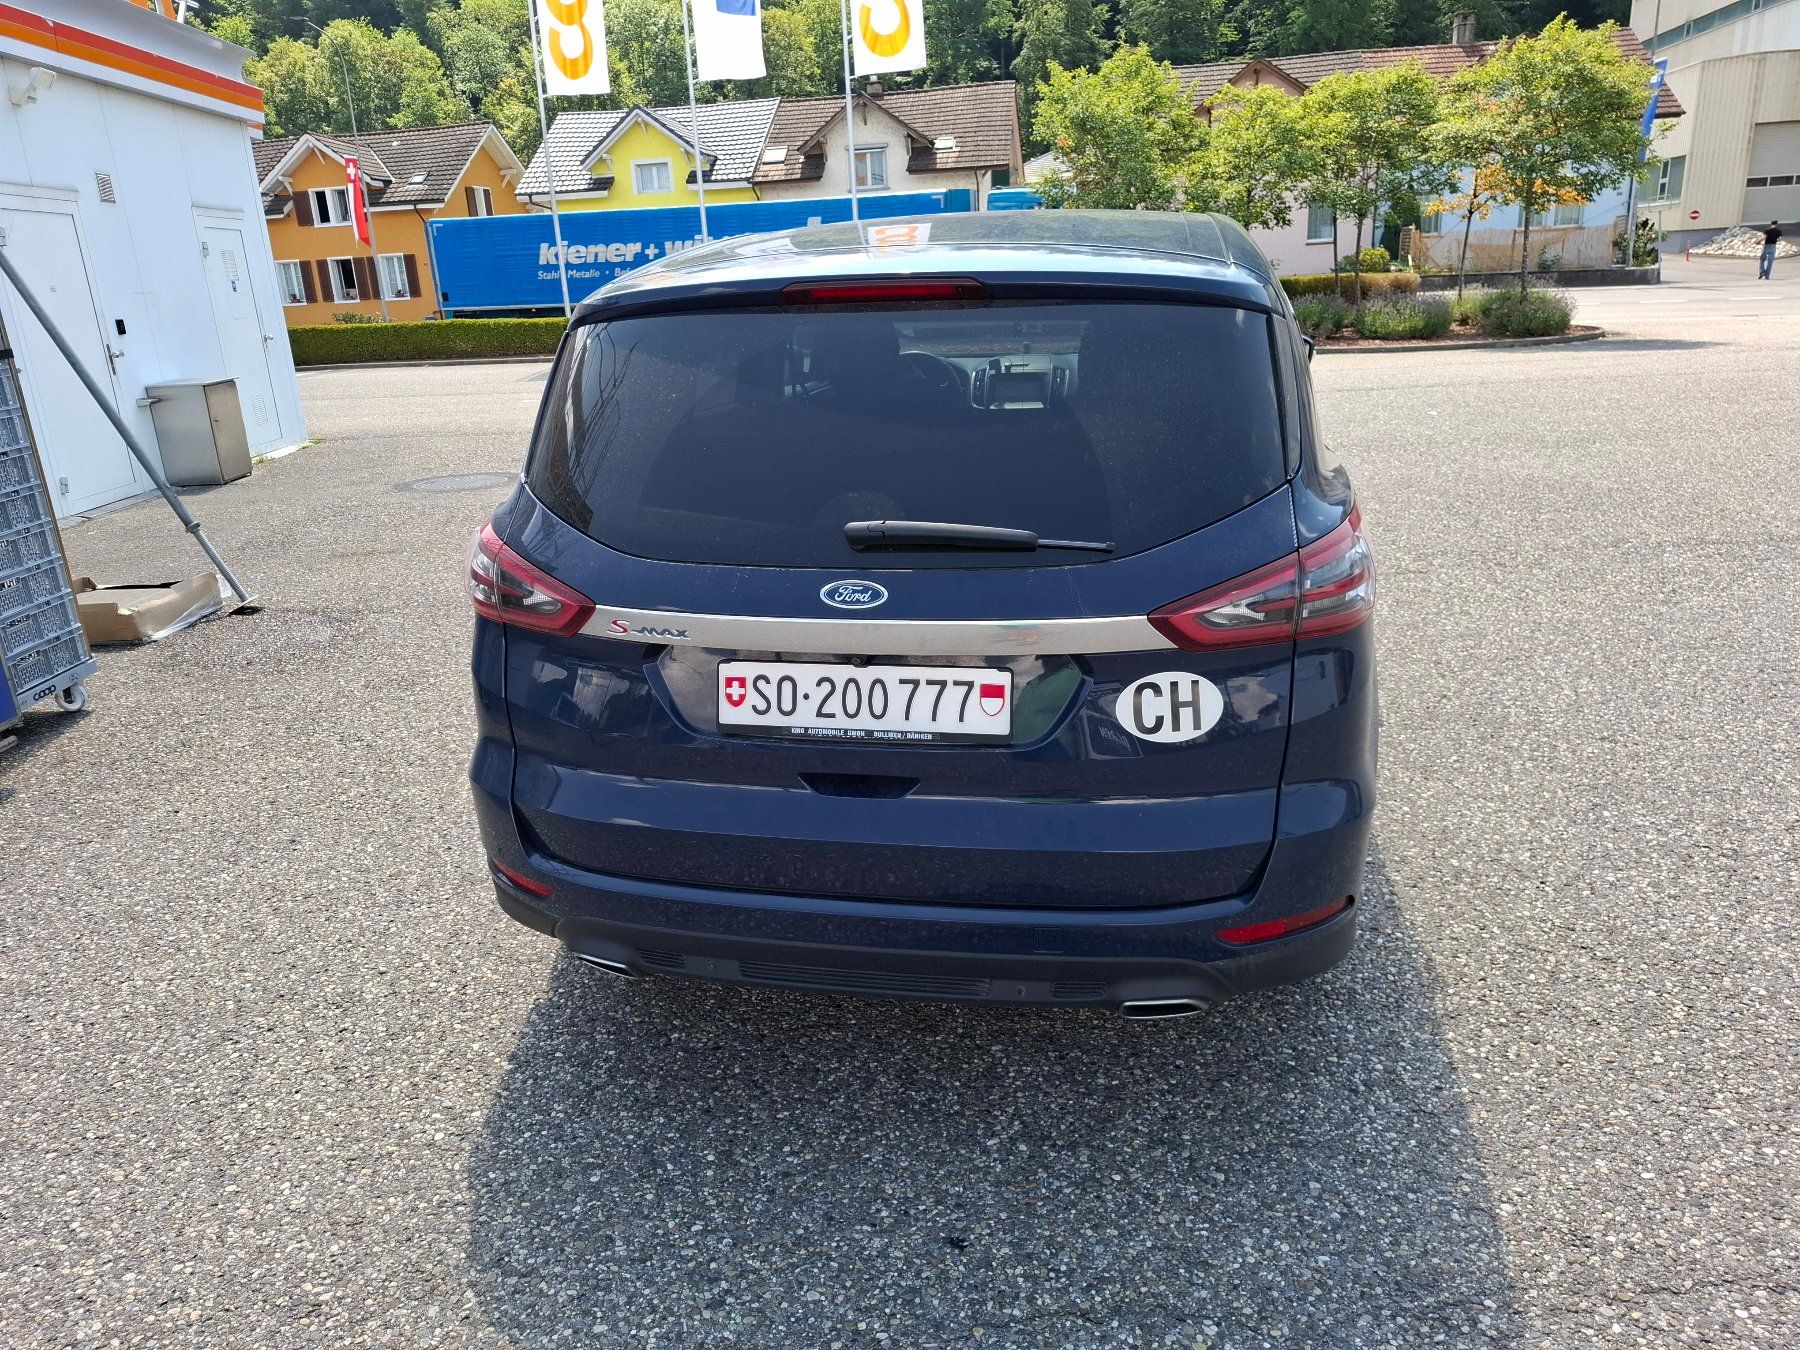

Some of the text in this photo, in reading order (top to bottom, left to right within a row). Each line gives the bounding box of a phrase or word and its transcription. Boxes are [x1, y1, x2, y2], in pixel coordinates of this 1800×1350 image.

[539, 241, 642, 265] kiener
[567, 268, 600, 279] Metalle
[834, 585, 872, 602] Ford
[607, 619, 691, 639] S-MAX
[1132, 679, 1202, 735] CH
